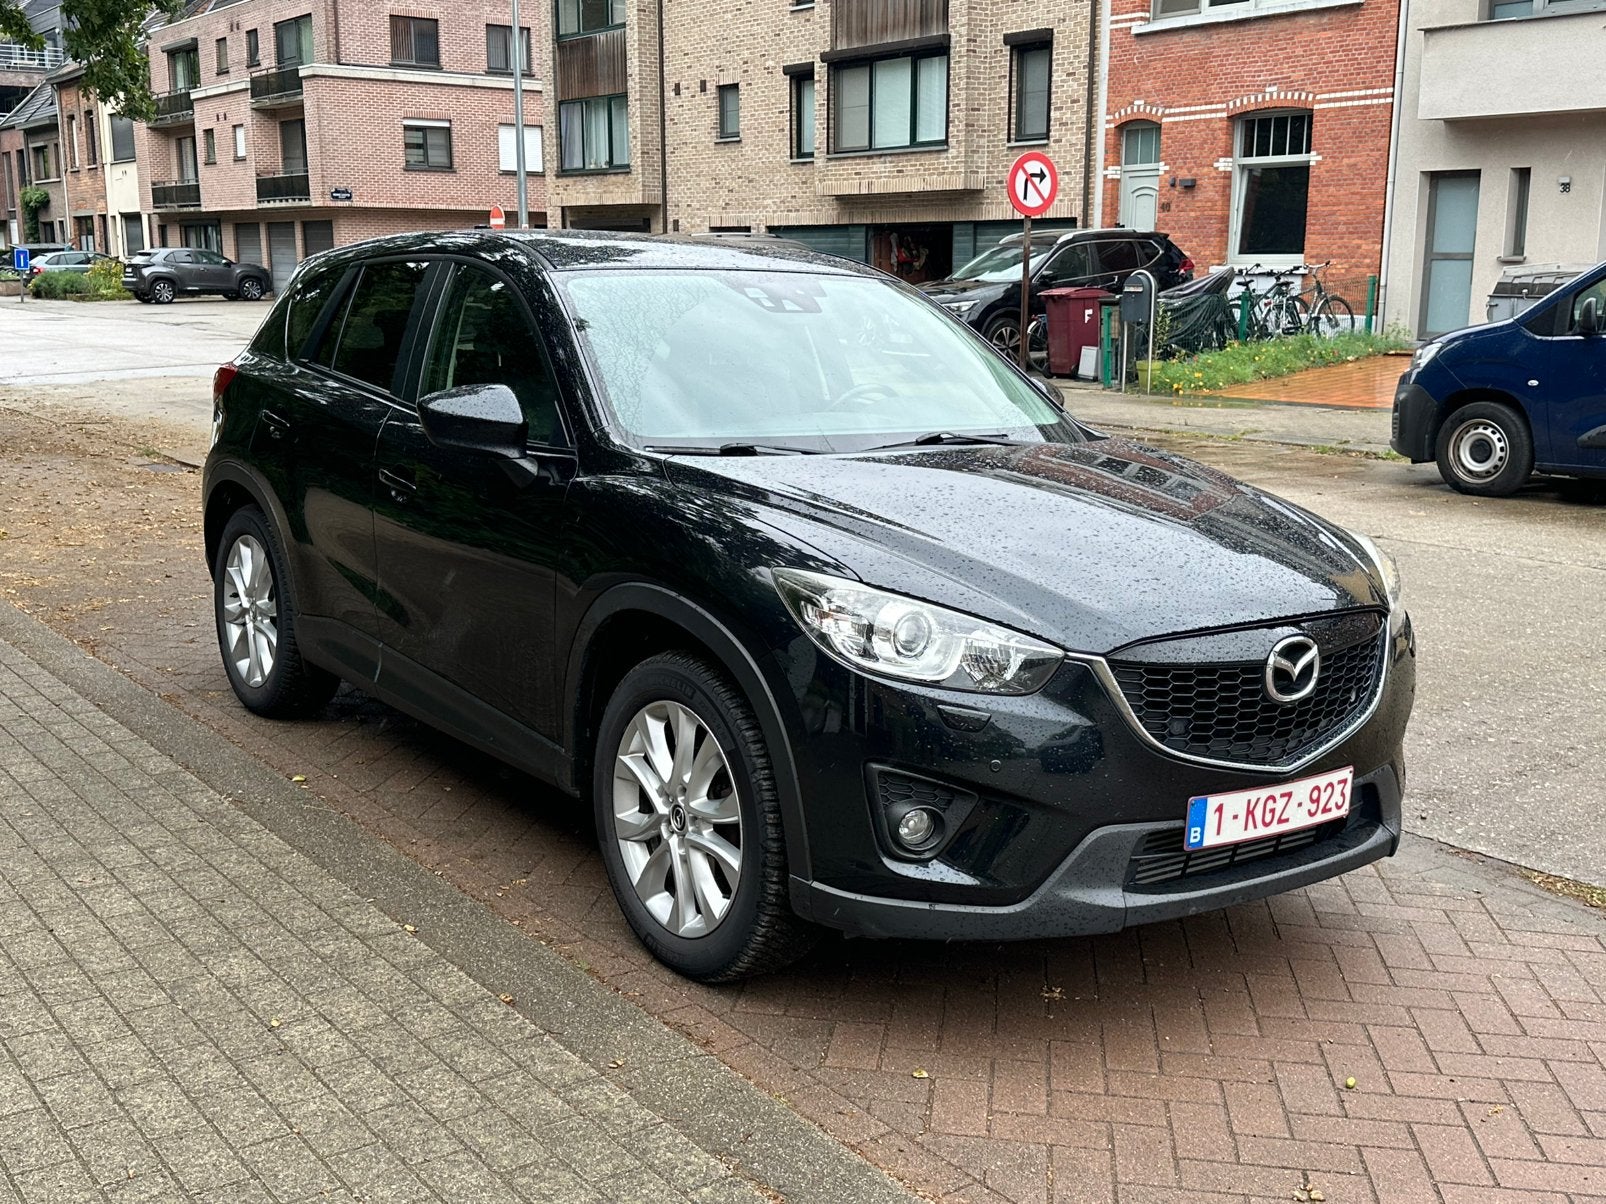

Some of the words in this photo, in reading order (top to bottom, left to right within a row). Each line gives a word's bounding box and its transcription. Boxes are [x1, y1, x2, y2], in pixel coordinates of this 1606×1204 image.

[1560, 183, 1571, 193] 38
[1213, 778, 1349, 836] 1-KGZ-923
[1189, 827, 1201, 843] B
